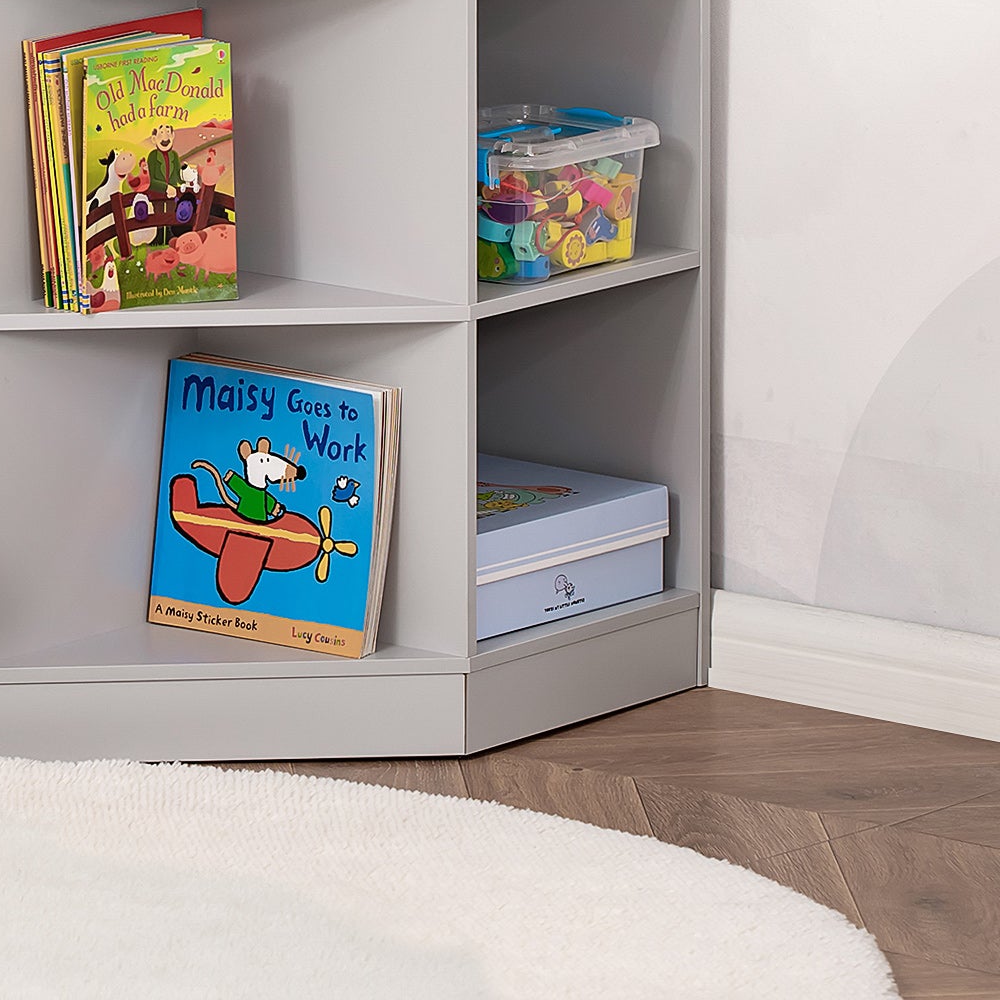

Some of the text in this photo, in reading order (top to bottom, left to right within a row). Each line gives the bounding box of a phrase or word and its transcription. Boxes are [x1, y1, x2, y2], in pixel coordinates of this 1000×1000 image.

[133, 55, 159, 64] READING
[96, 80, 125, 111] Old
[107, 93, 189, 132] had a farm
[181, 374, 359, 421] Maisy Goes to
[302, 419, 367, 463] Work
[155, 603, 259, 631] A Maisy Sticker Book
[291, 626, 346, 647] Lucy Cousins
